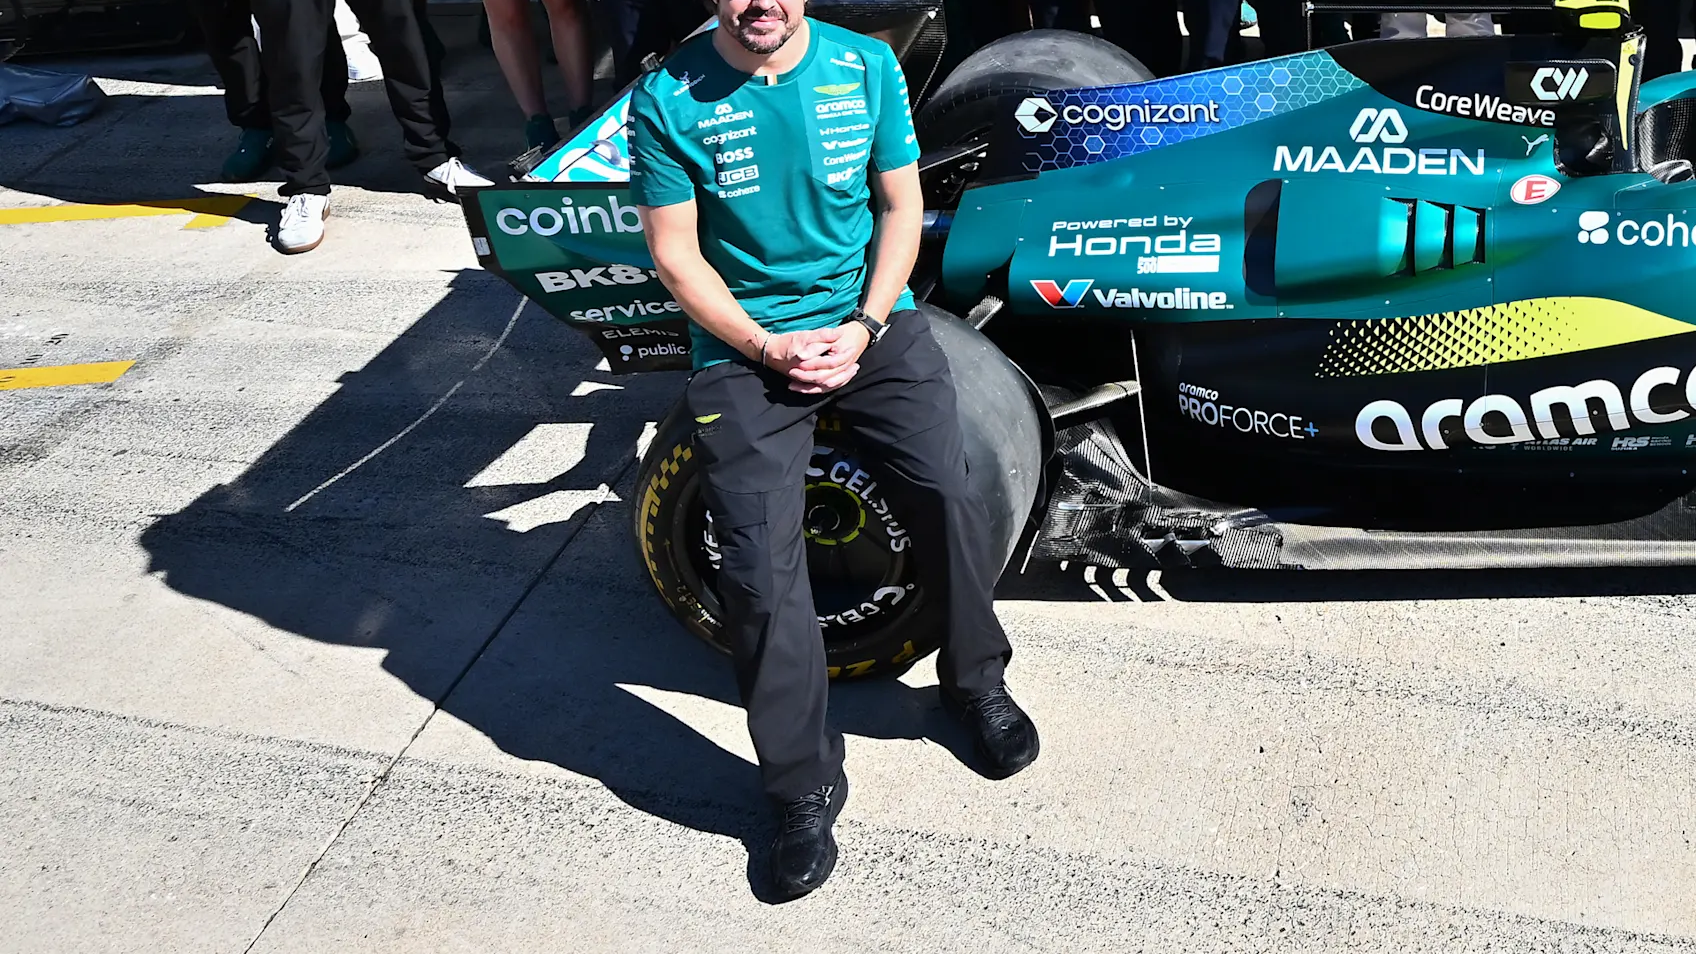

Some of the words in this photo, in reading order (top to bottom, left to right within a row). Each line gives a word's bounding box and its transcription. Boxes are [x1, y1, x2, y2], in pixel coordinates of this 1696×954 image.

[815, 99, 866, 114] aramco
[1063, 99, 1219, 131] cognizant
[1416, 85, 1556, 126] CoreWeave
[698, 110, 754, 129] MAADEN
[830, 123, 870, 135] Honda
[703, 125, 757, 146] cognizant
[715, 147, 754, 165] BOSS
[1273, 146, 1485, 175] MAADEN
[719, 168, 757, 184] JCB
[1523, 179, 1549, 202] E
[1053, 216, 1157, 231] Powered
[1164, 215, 1193, 228] by
[1048, 230, 1221, 257] Honda
[1136, 262, 1158, 275] 500
[535, 264, 648, 293] BK8
[1093, 287, 1227, 310] Valvoline
[1179, 382, 1219, 401] aramco
[1179, 394, 1319, 440] PROFORCE+
[1572, 437, 1598, 446] AIR
[1612, 436, 1650, 447] HRS
